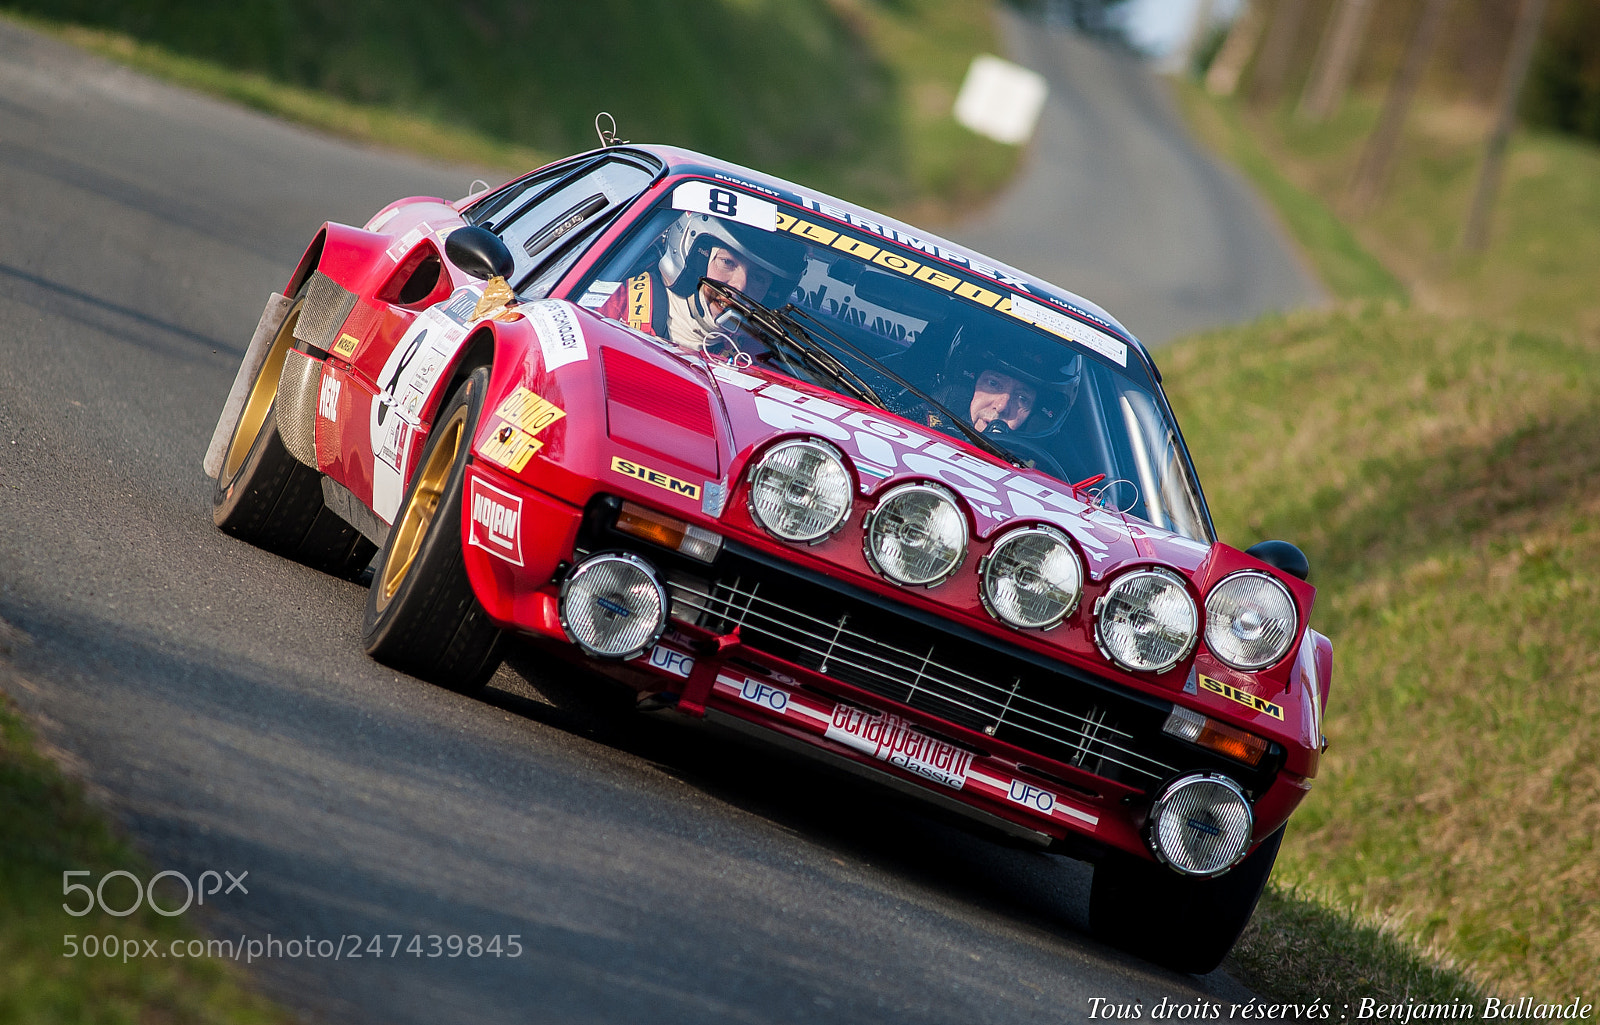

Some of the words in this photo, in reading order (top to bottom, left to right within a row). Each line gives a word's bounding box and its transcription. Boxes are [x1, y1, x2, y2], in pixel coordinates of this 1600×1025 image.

[715, 174, 780, 197] BUDAPEST
[709, 188, 738, 217] 8
[792, 192, 1031, 294] TERIMPEX
[1049, 297, 1111, 328] HUNGARY
[503, 392, 555, 429] OLIO
[614, 460, 696, 498] SIEM
[754, 396, 1110, 552] PICK
[473, 492, 518, 551] NOLAN
[652, 647, 696, 677] UFO
[742, 678, 788, 710] UFO
[1203, 677, 1281, 719] SIEM
[890, 756, 963, 789] classic
[1009, 780, 1054, 811] UFO
